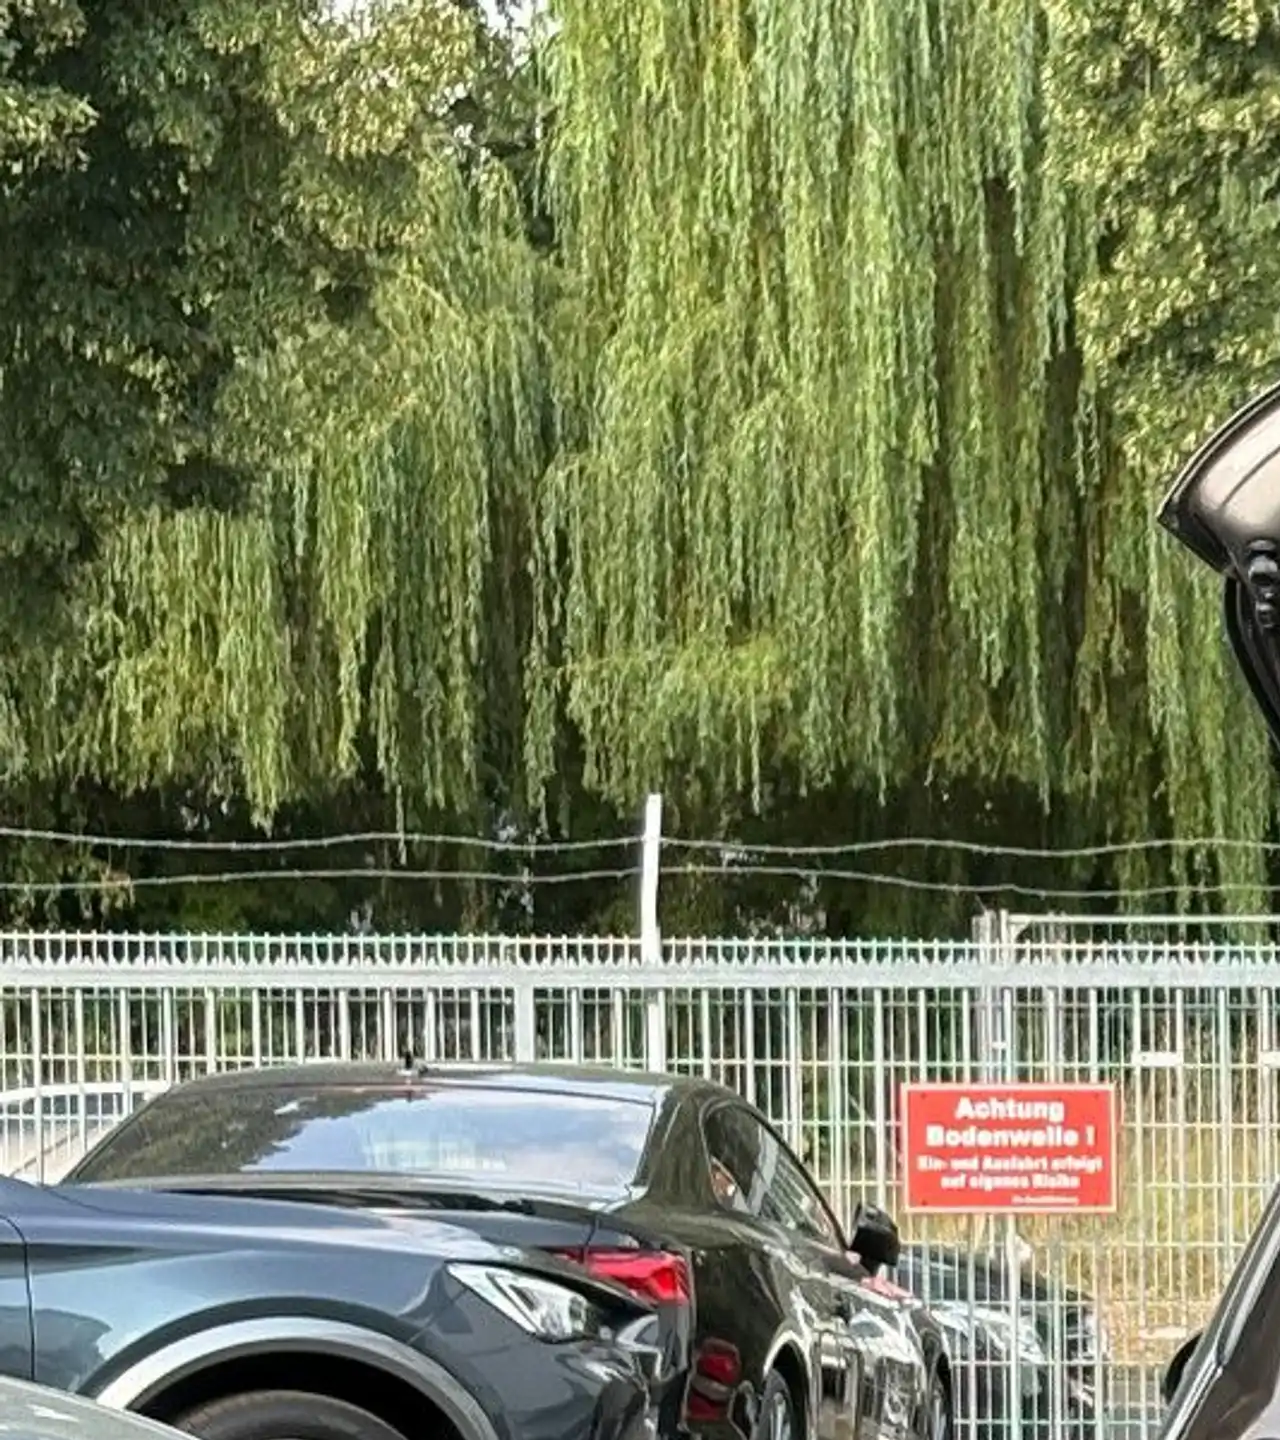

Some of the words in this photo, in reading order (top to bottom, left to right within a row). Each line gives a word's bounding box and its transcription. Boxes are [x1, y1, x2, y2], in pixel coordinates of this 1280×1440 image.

[955, 1097, 1065, 1122] Achtung
[926, 1124, 1078, 1147] Bodenwelle
[950, 1155, 979, 1170] und
[941, 1174, 966, 1189] auf
